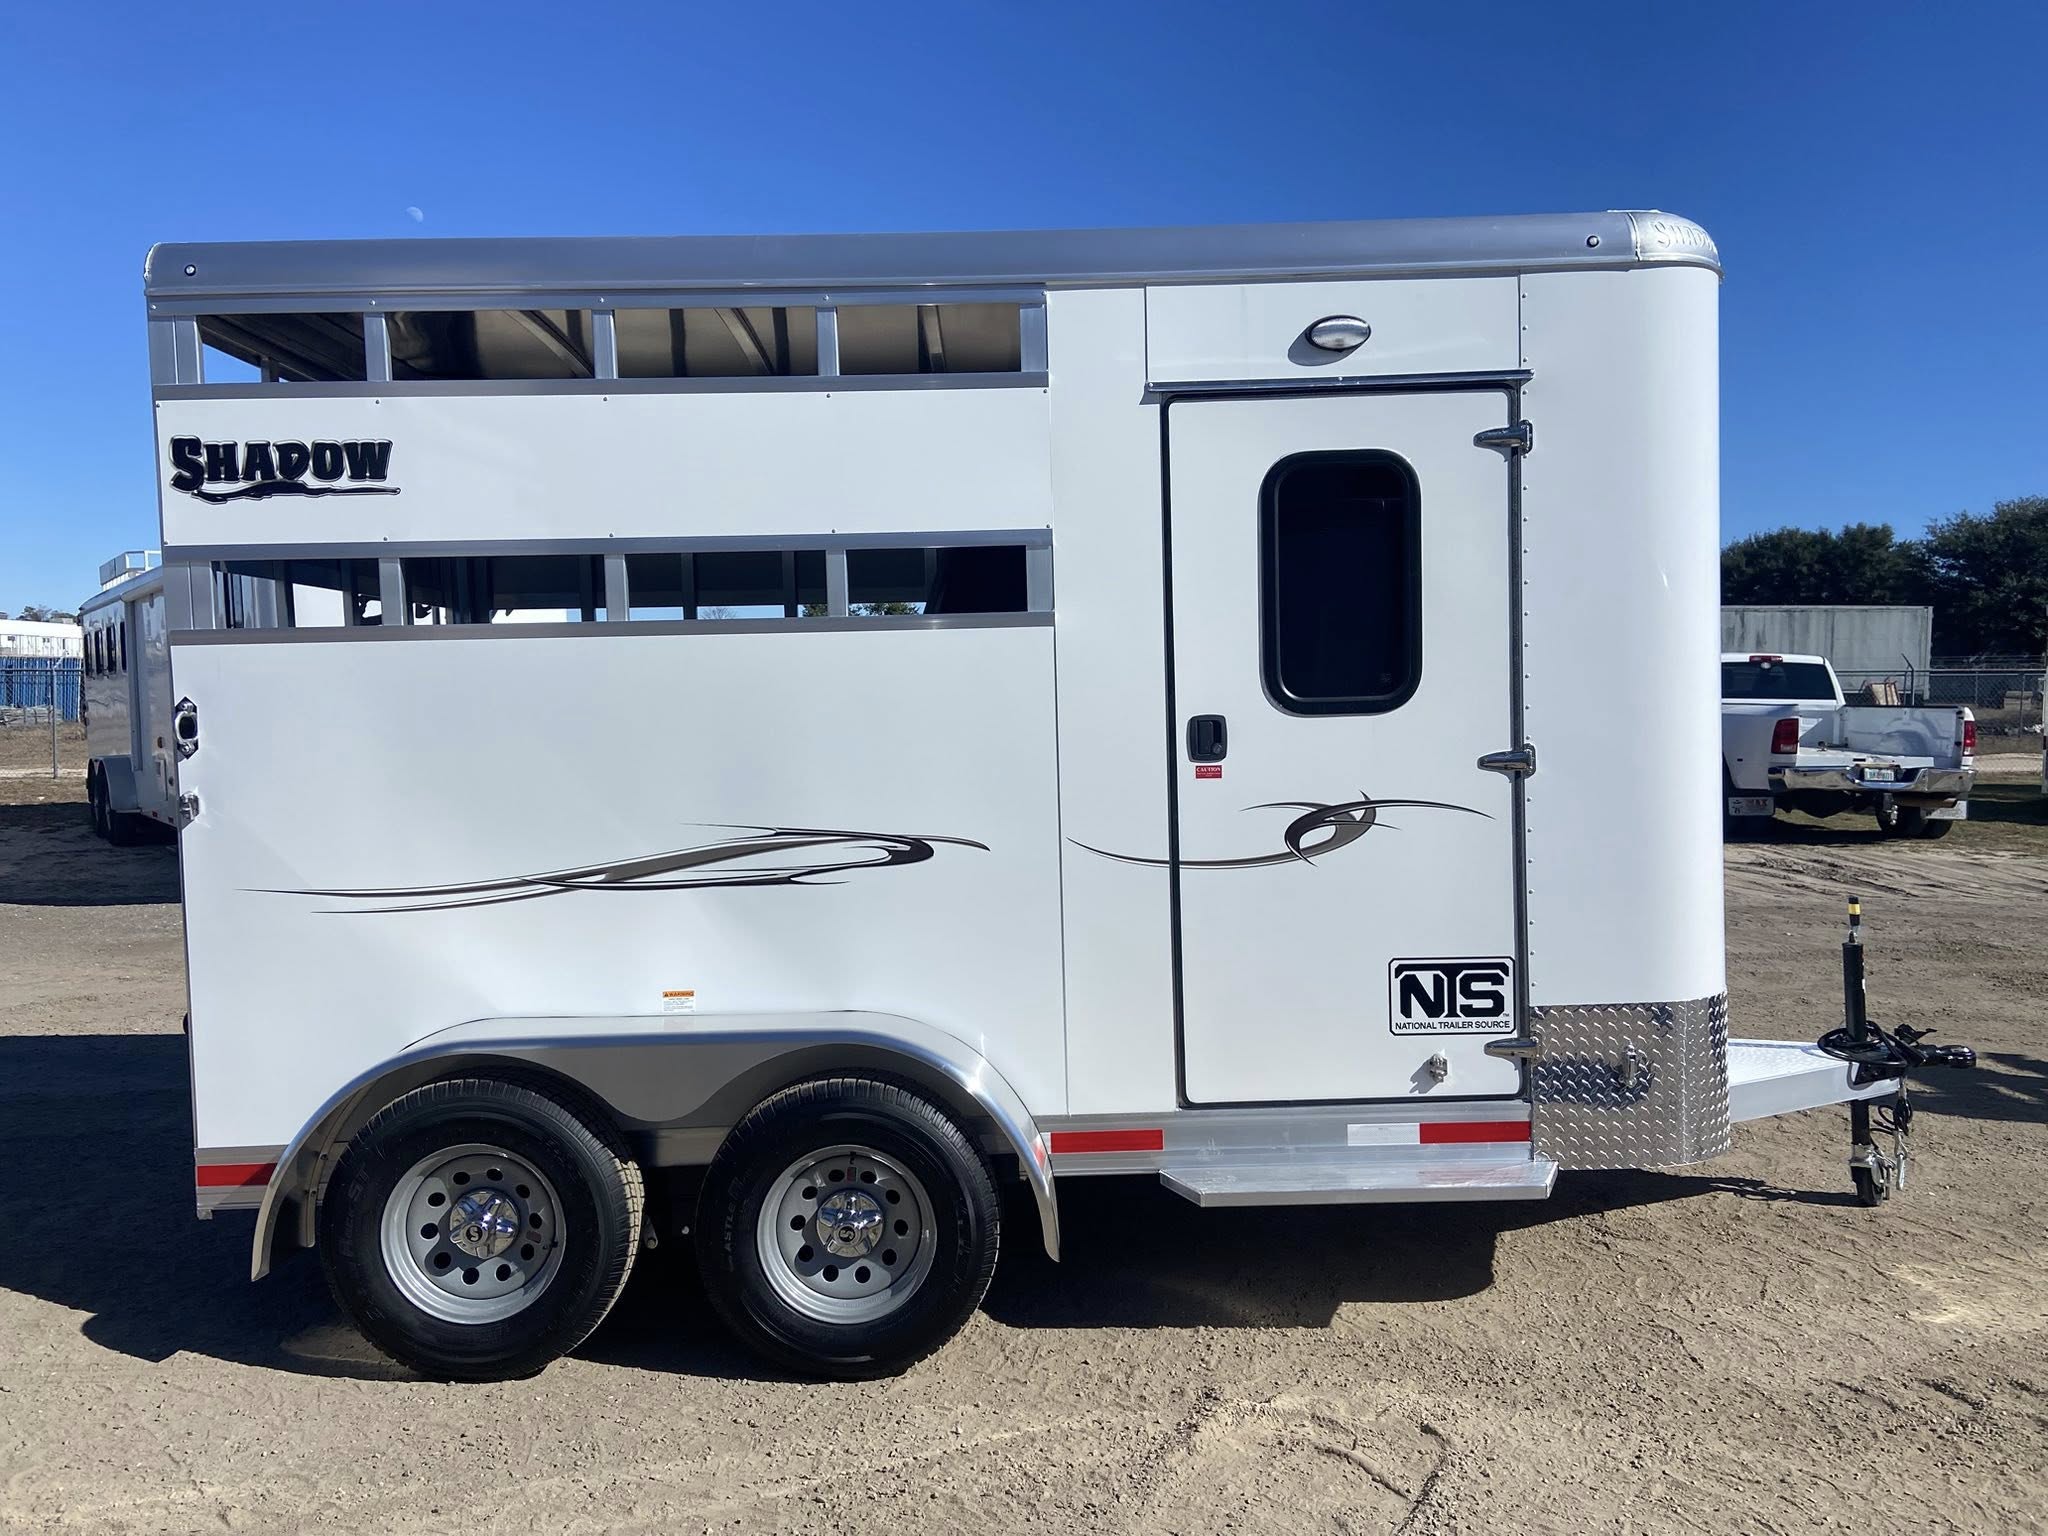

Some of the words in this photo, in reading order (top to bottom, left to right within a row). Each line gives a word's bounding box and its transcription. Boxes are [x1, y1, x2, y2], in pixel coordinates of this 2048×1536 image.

[169, 435, 393, 493] SHADOW
[1394, 961, 1510, 1019] NTS
[1395, 1021, 1437, 1030] NATIONAL
[1438, 1020, 1473, 1029] TRAILER
[1474, 1020, 1510, 1028] SOURCE
